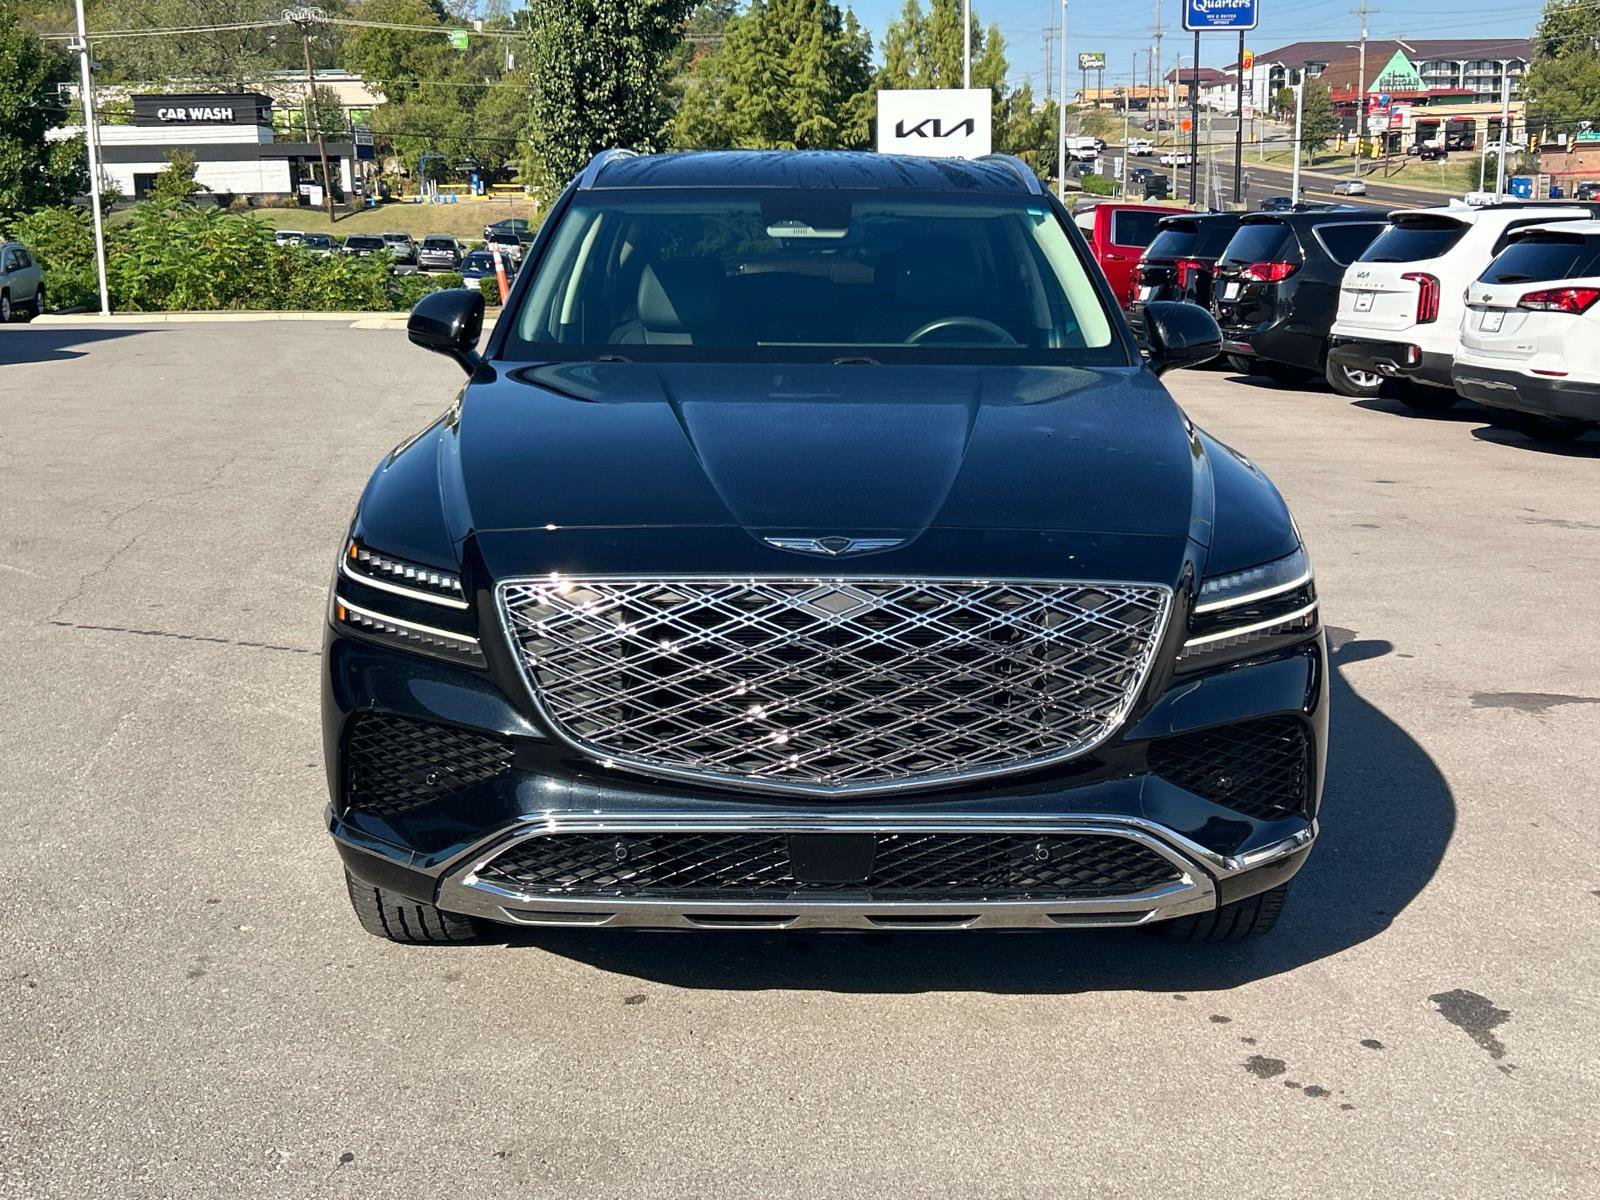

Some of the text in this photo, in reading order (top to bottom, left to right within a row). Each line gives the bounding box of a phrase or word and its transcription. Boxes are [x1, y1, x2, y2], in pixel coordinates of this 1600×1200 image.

[1193, 0, 1251, 13] Quarters
[157, 107, 234, 121] CAR WASH
[895, 118, 975, 138] KIA
